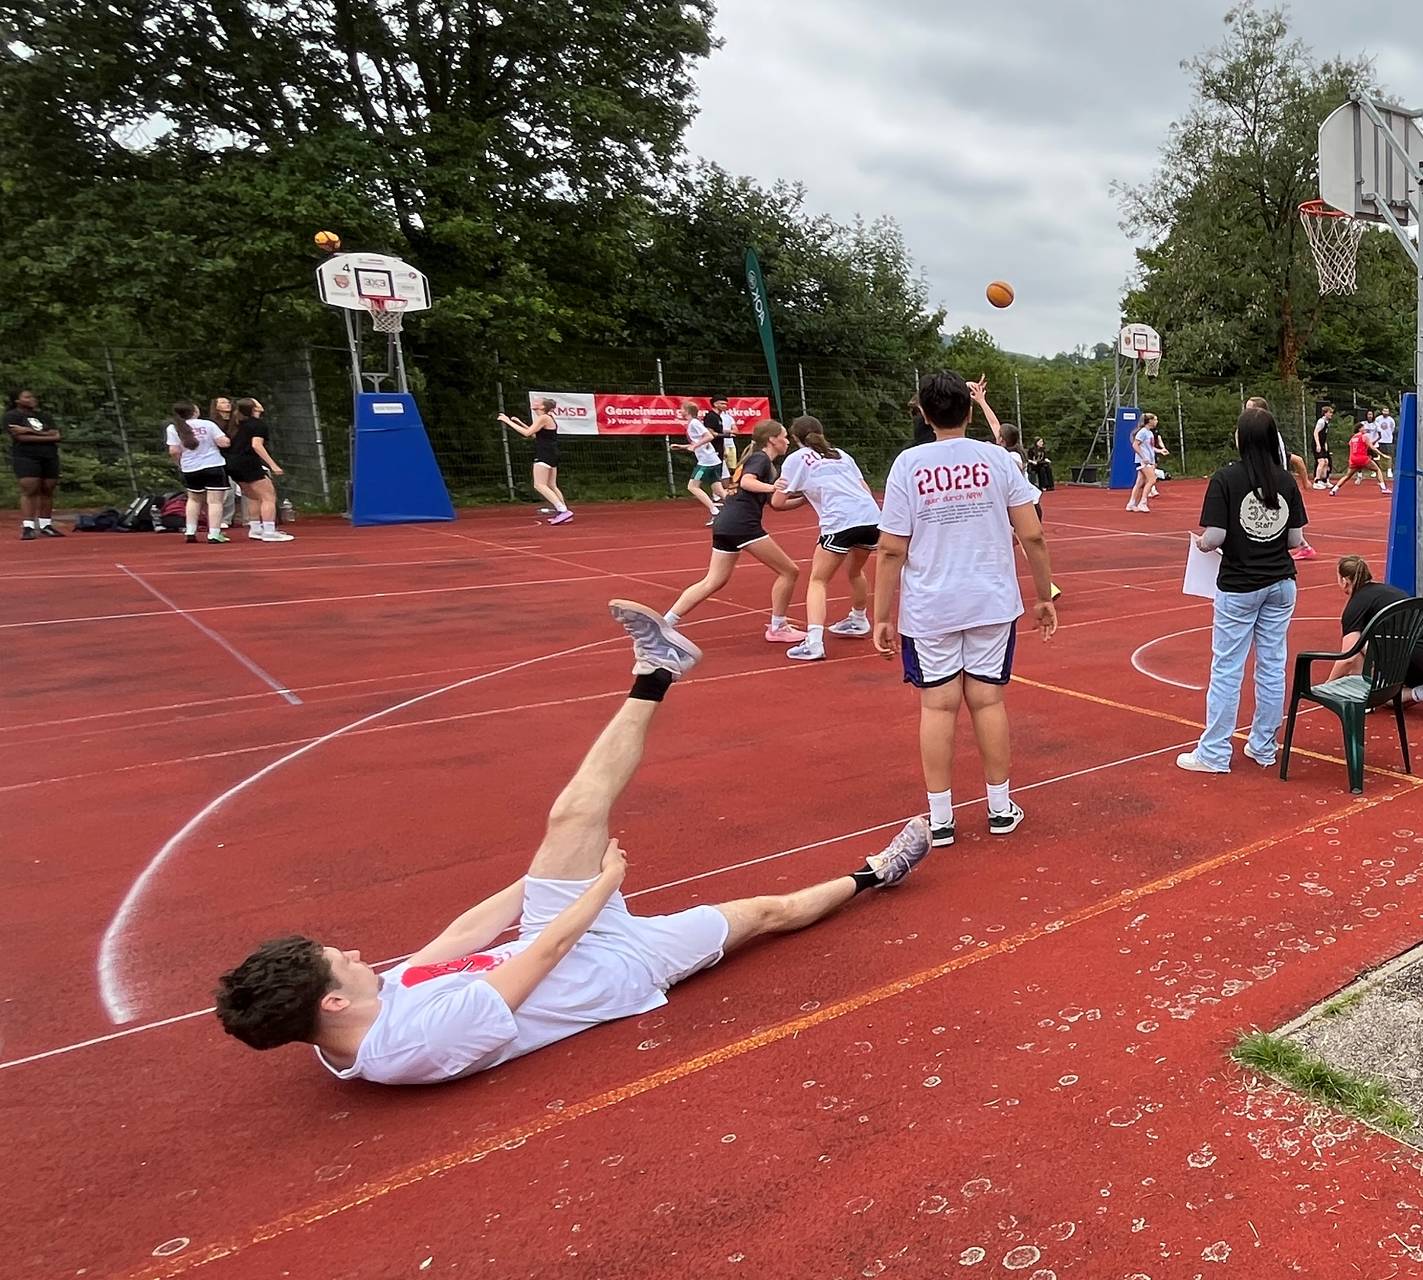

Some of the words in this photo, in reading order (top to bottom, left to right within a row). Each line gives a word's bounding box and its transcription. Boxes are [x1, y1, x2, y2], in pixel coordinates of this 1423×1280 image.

[342, 263, 351, 273] 4
[751, 287, 765, 327] AOK
[604, 405, 675, 416] Gemeinsam
[914, 463, 990, 496] 2026
[943, 493, 964, 503] durch
[966, 491, 983, 501] NRW
[1255, 521, 1274, 529] Staff
